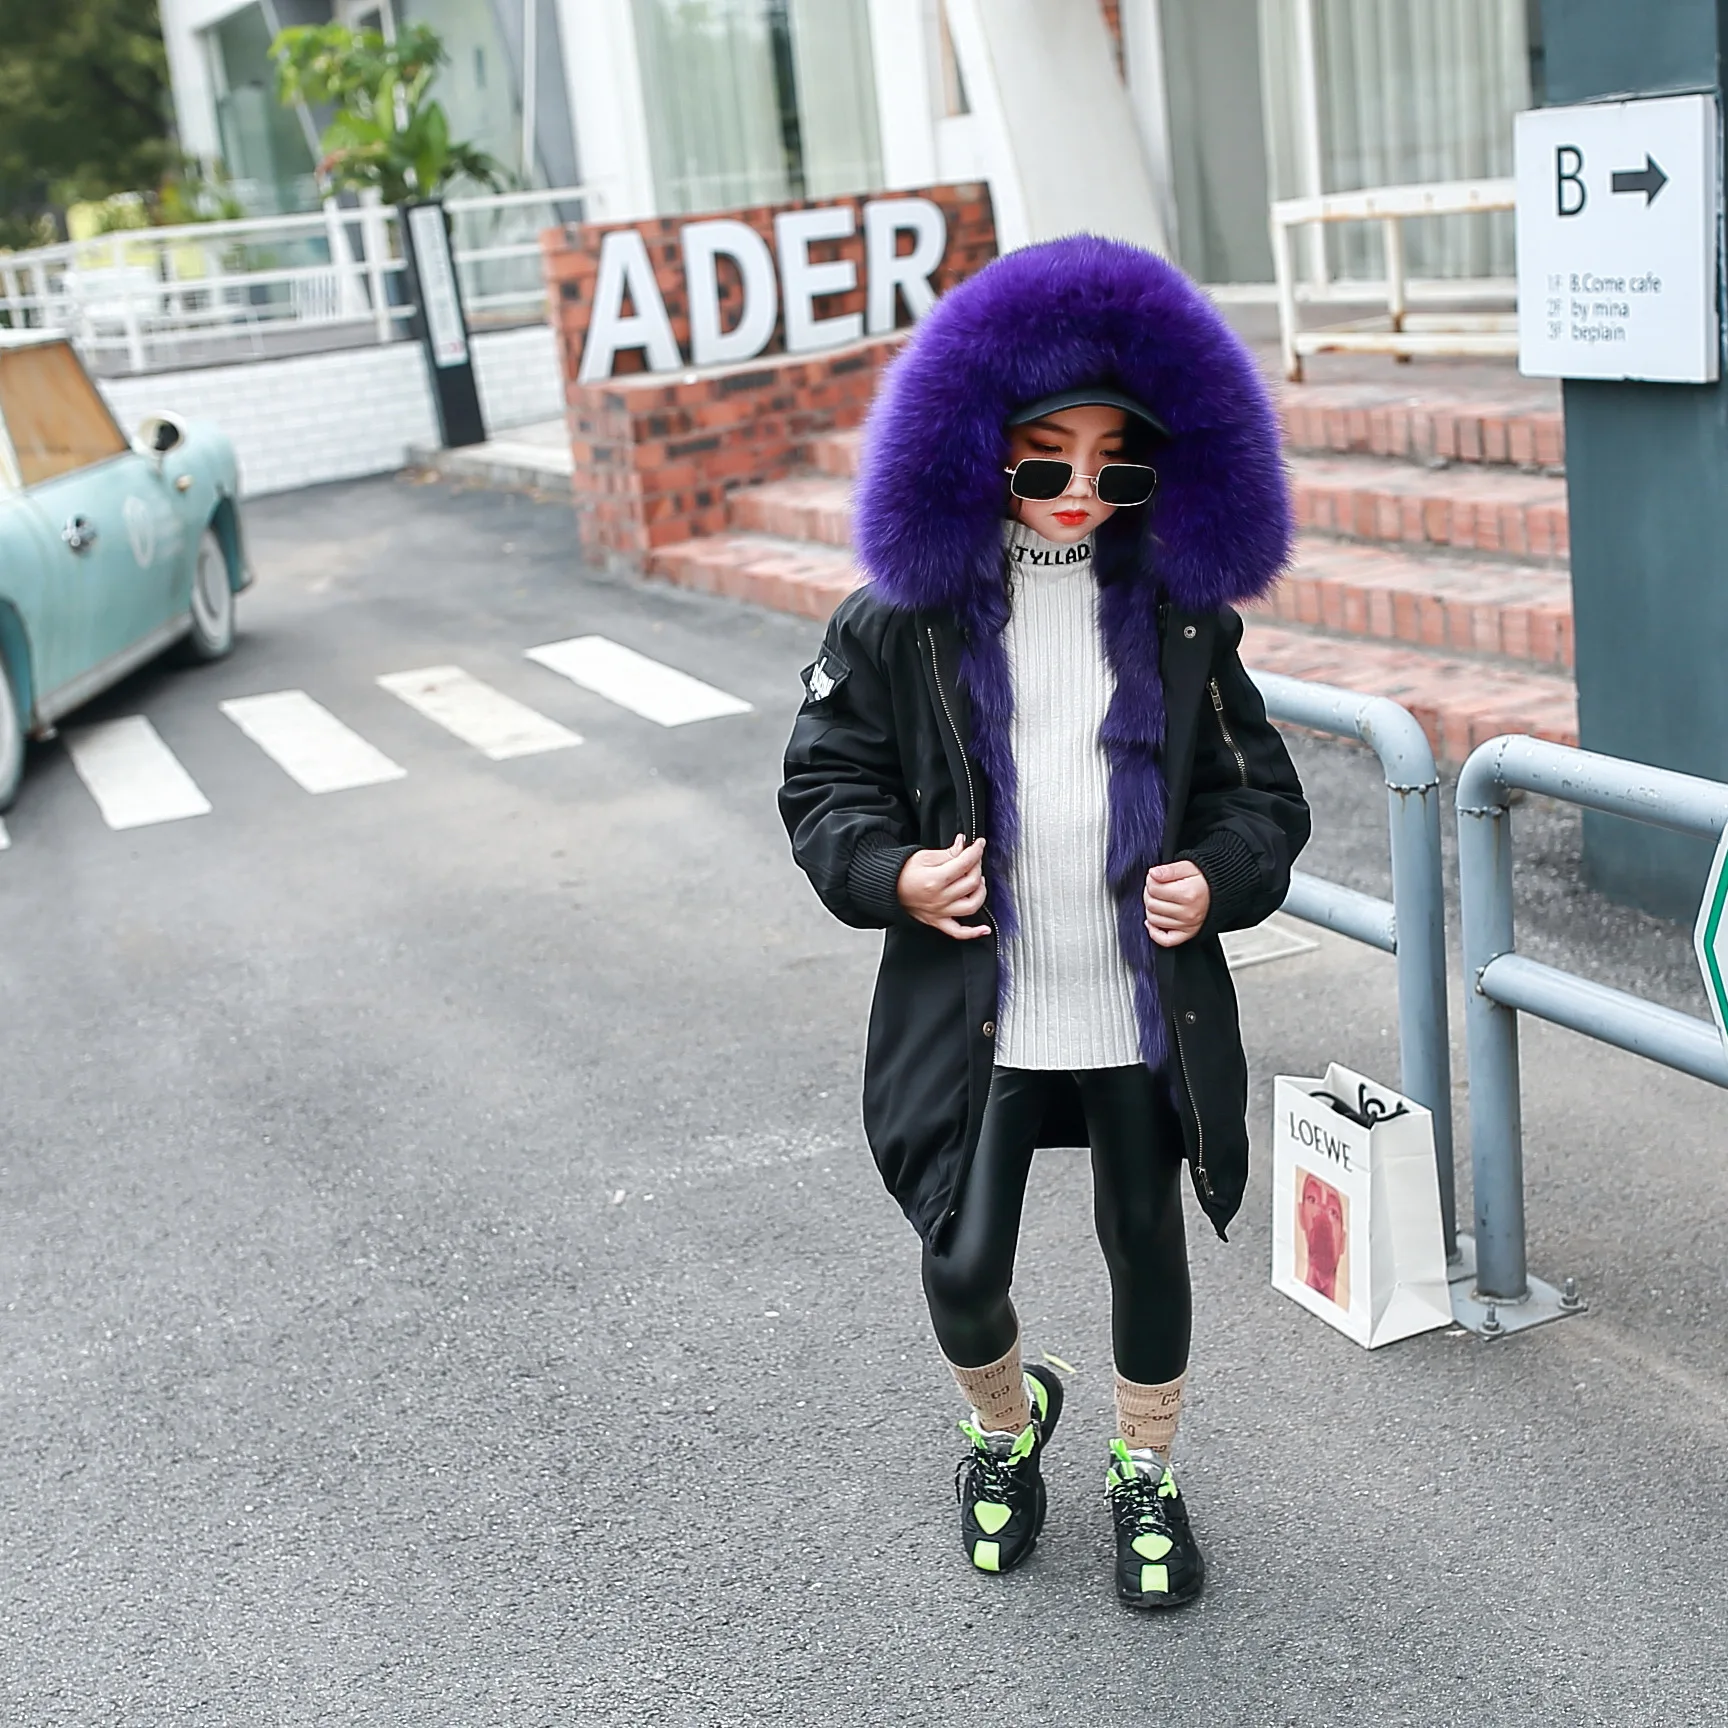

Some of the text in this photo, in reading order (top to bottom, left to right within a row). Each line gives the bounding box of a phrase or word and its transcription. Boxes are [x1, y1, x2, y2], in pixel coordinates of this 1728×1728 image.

[1556, 145, 1586, 216] B
[578, 198, 948, 385] ADER
[1629, 271, 1662, 293] cafe
[1571, 297, 1589, 321] by
[1592, 298, 1630, 318] mina
[1571, 320, 1626, 344] beplain
[1290, 1111, 1353, 1173] LOEWE
